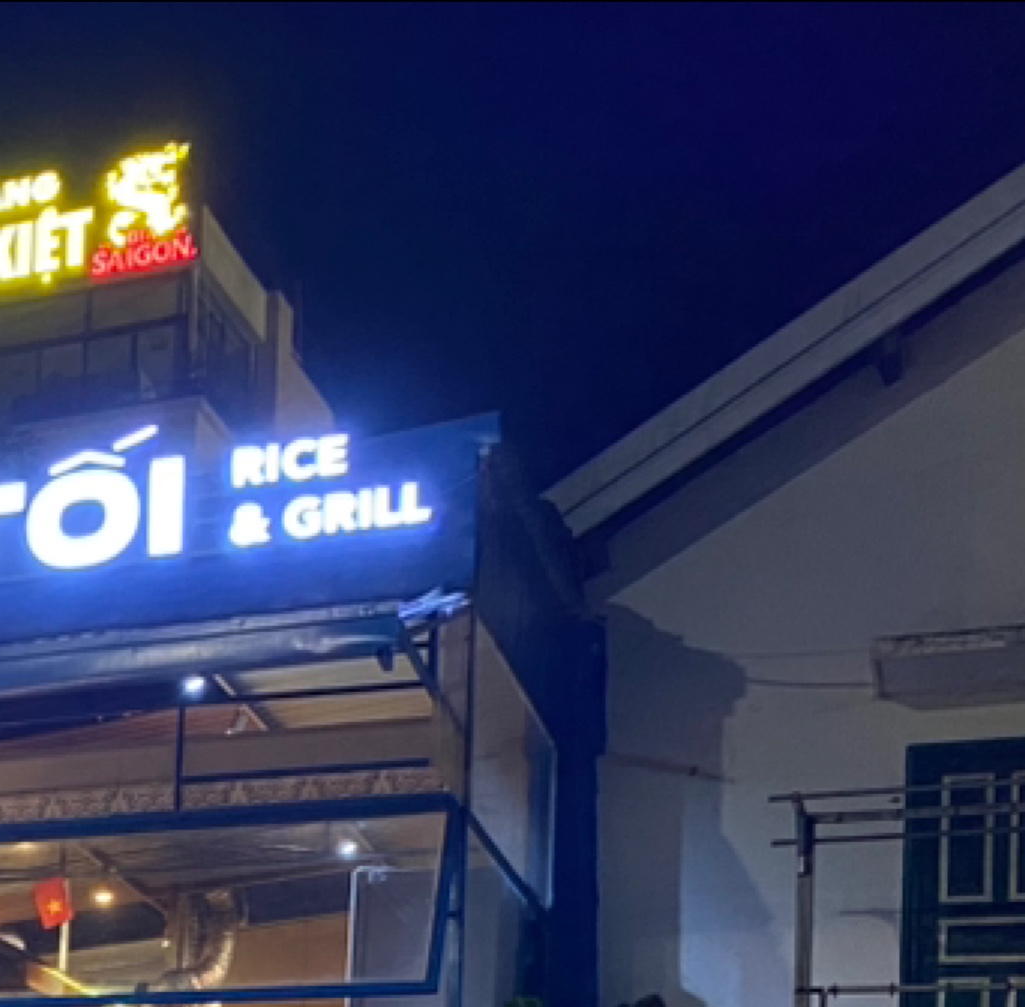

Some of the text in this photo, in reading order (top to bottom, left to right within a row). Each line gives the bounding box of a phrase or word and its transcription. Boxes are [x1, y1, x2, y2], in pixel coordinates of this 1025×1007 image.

[231, 433, 348, 488] RICE
[229, 482, 432, 547] & GRILL
